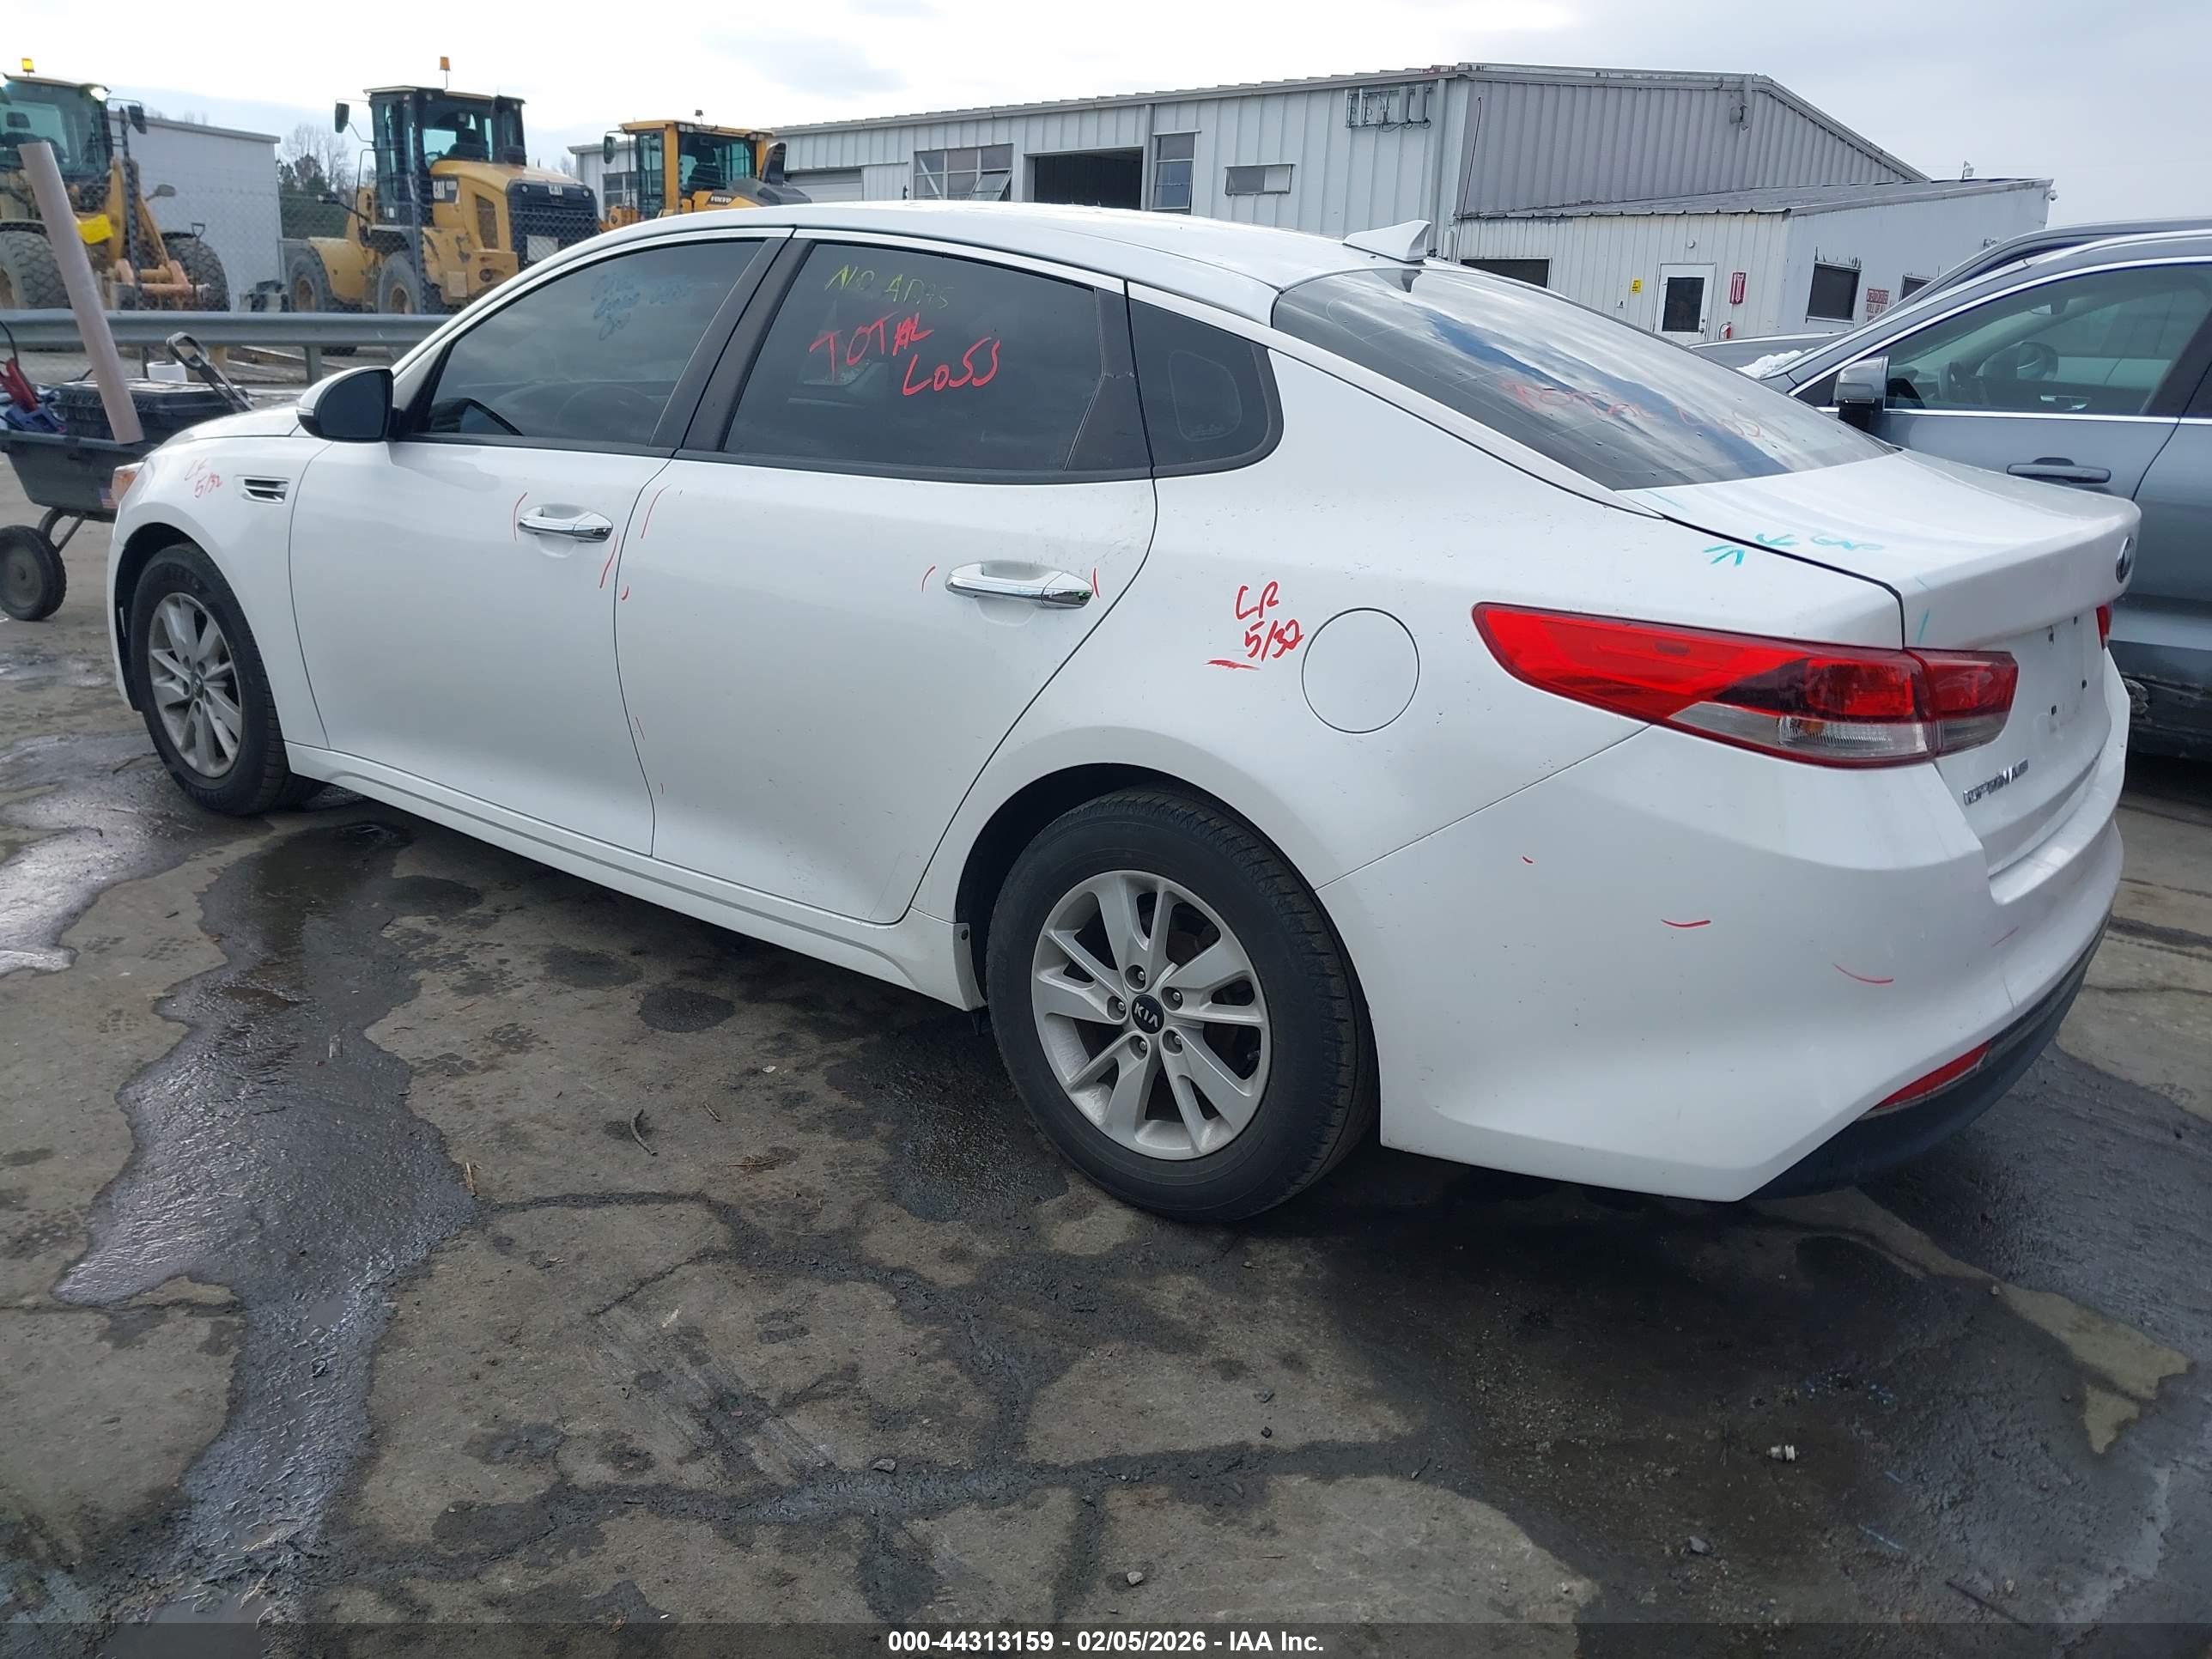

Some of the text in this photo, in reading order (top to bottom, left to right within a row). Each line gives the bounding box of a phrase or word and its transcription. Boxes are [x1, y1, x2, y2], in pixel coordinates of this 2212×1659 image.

[824, 264, 876, 293] NO
[809, 311, 935, 385] TOTAL
[902, 337, 1002, 396] LOSS
[1235, 580, 1279, 620] LR
[1133, 1001, 1158, 1028] KIA
